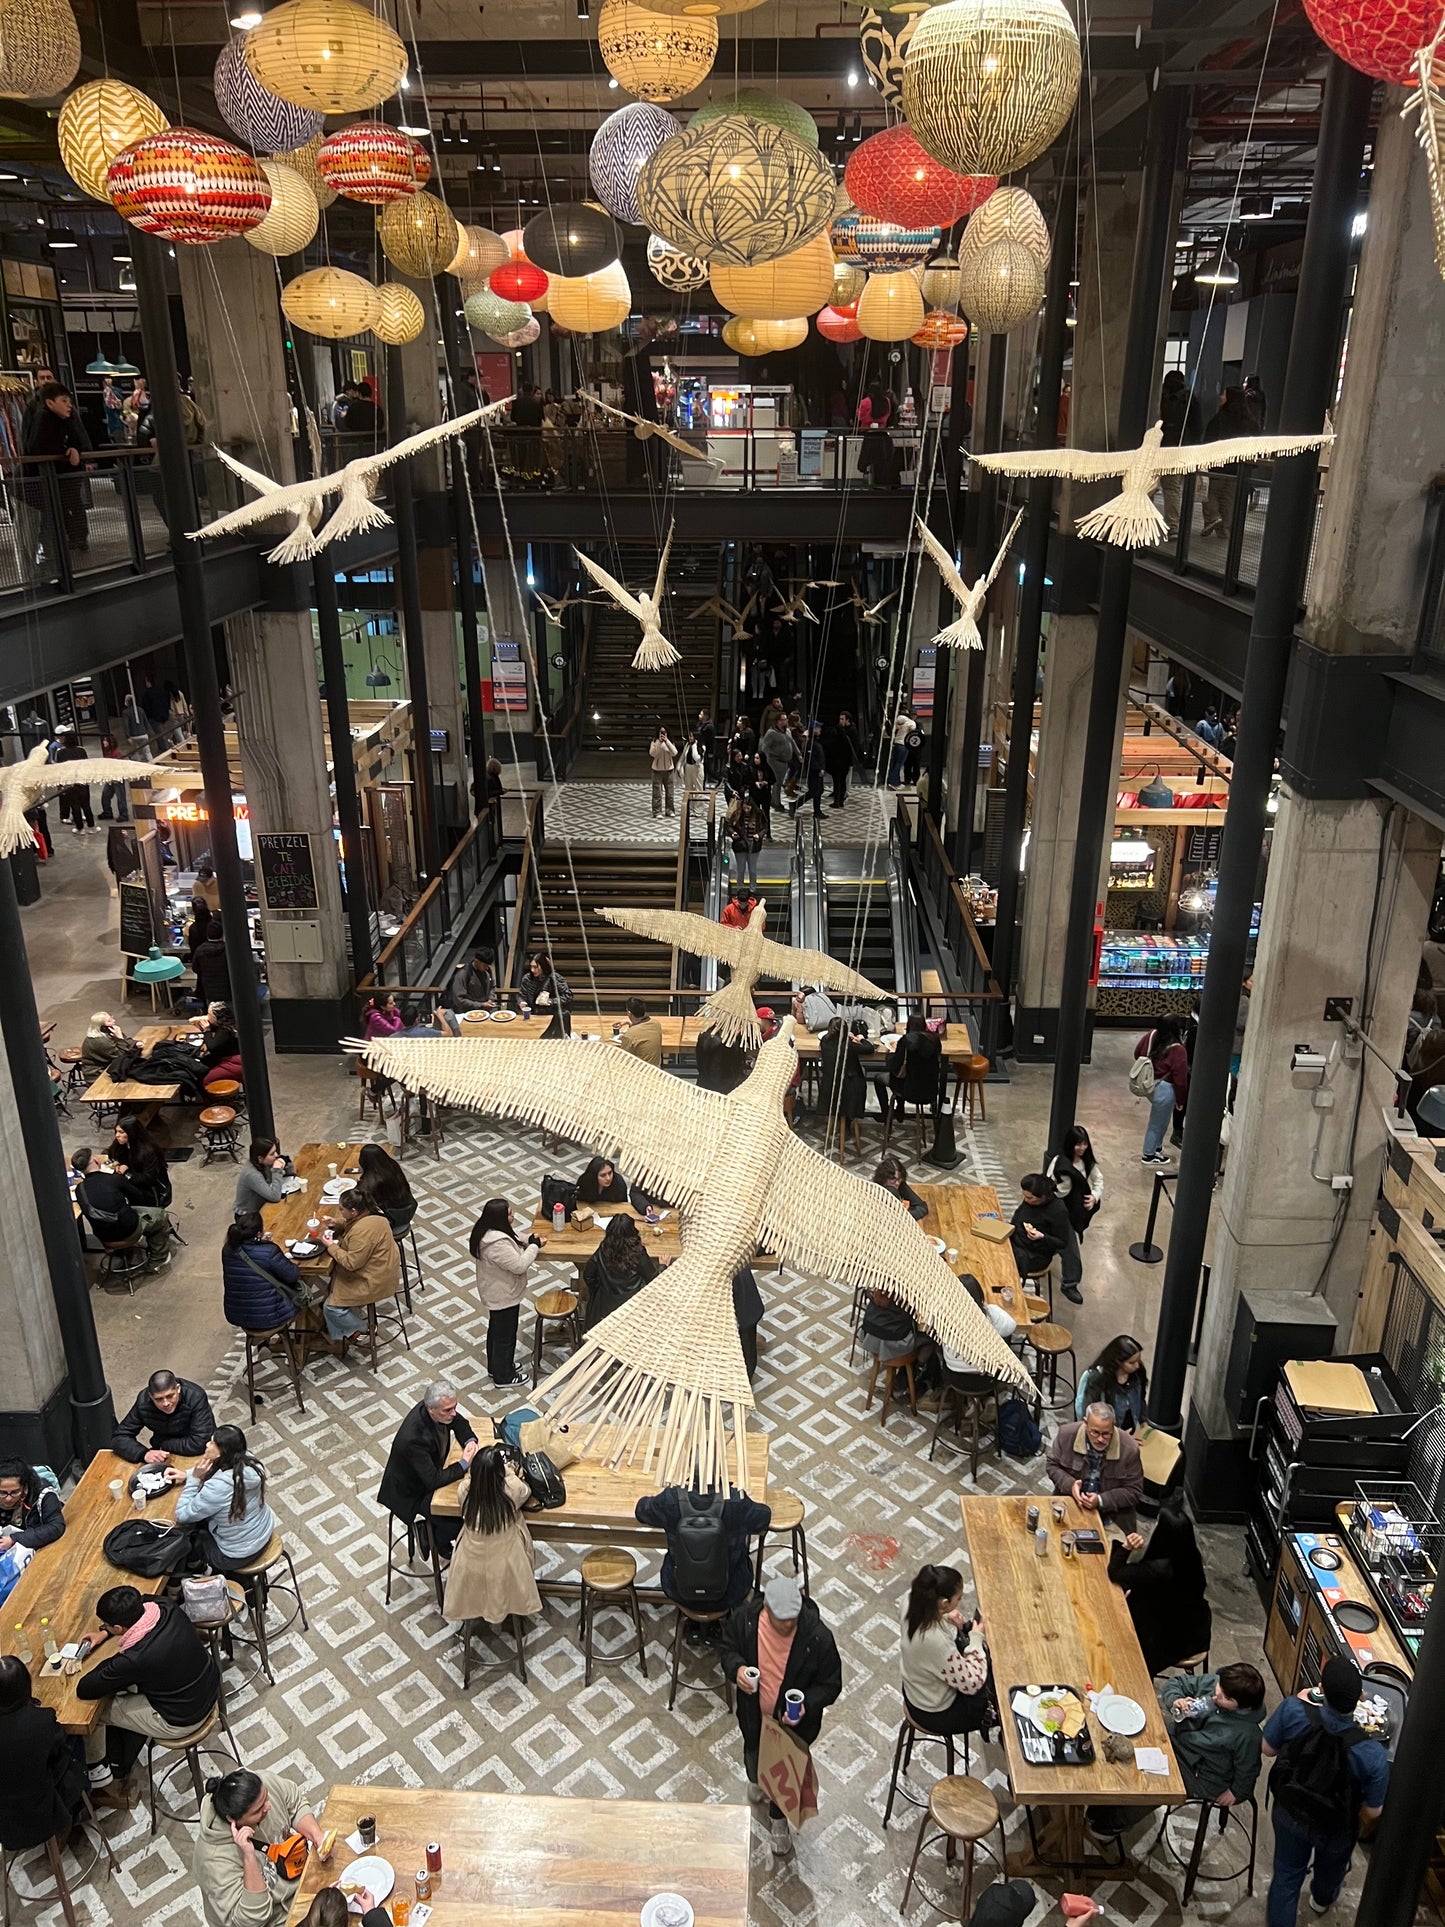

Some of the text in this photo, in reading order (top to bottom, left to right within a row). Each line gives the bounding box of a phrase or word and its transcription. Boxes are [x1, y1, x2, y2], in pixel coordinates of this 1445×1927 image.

[260, 836, 307, 849] PRETZEL
[277, 851, 293, 862] TE
[265, 873, 312, 889] BEBIDAS
